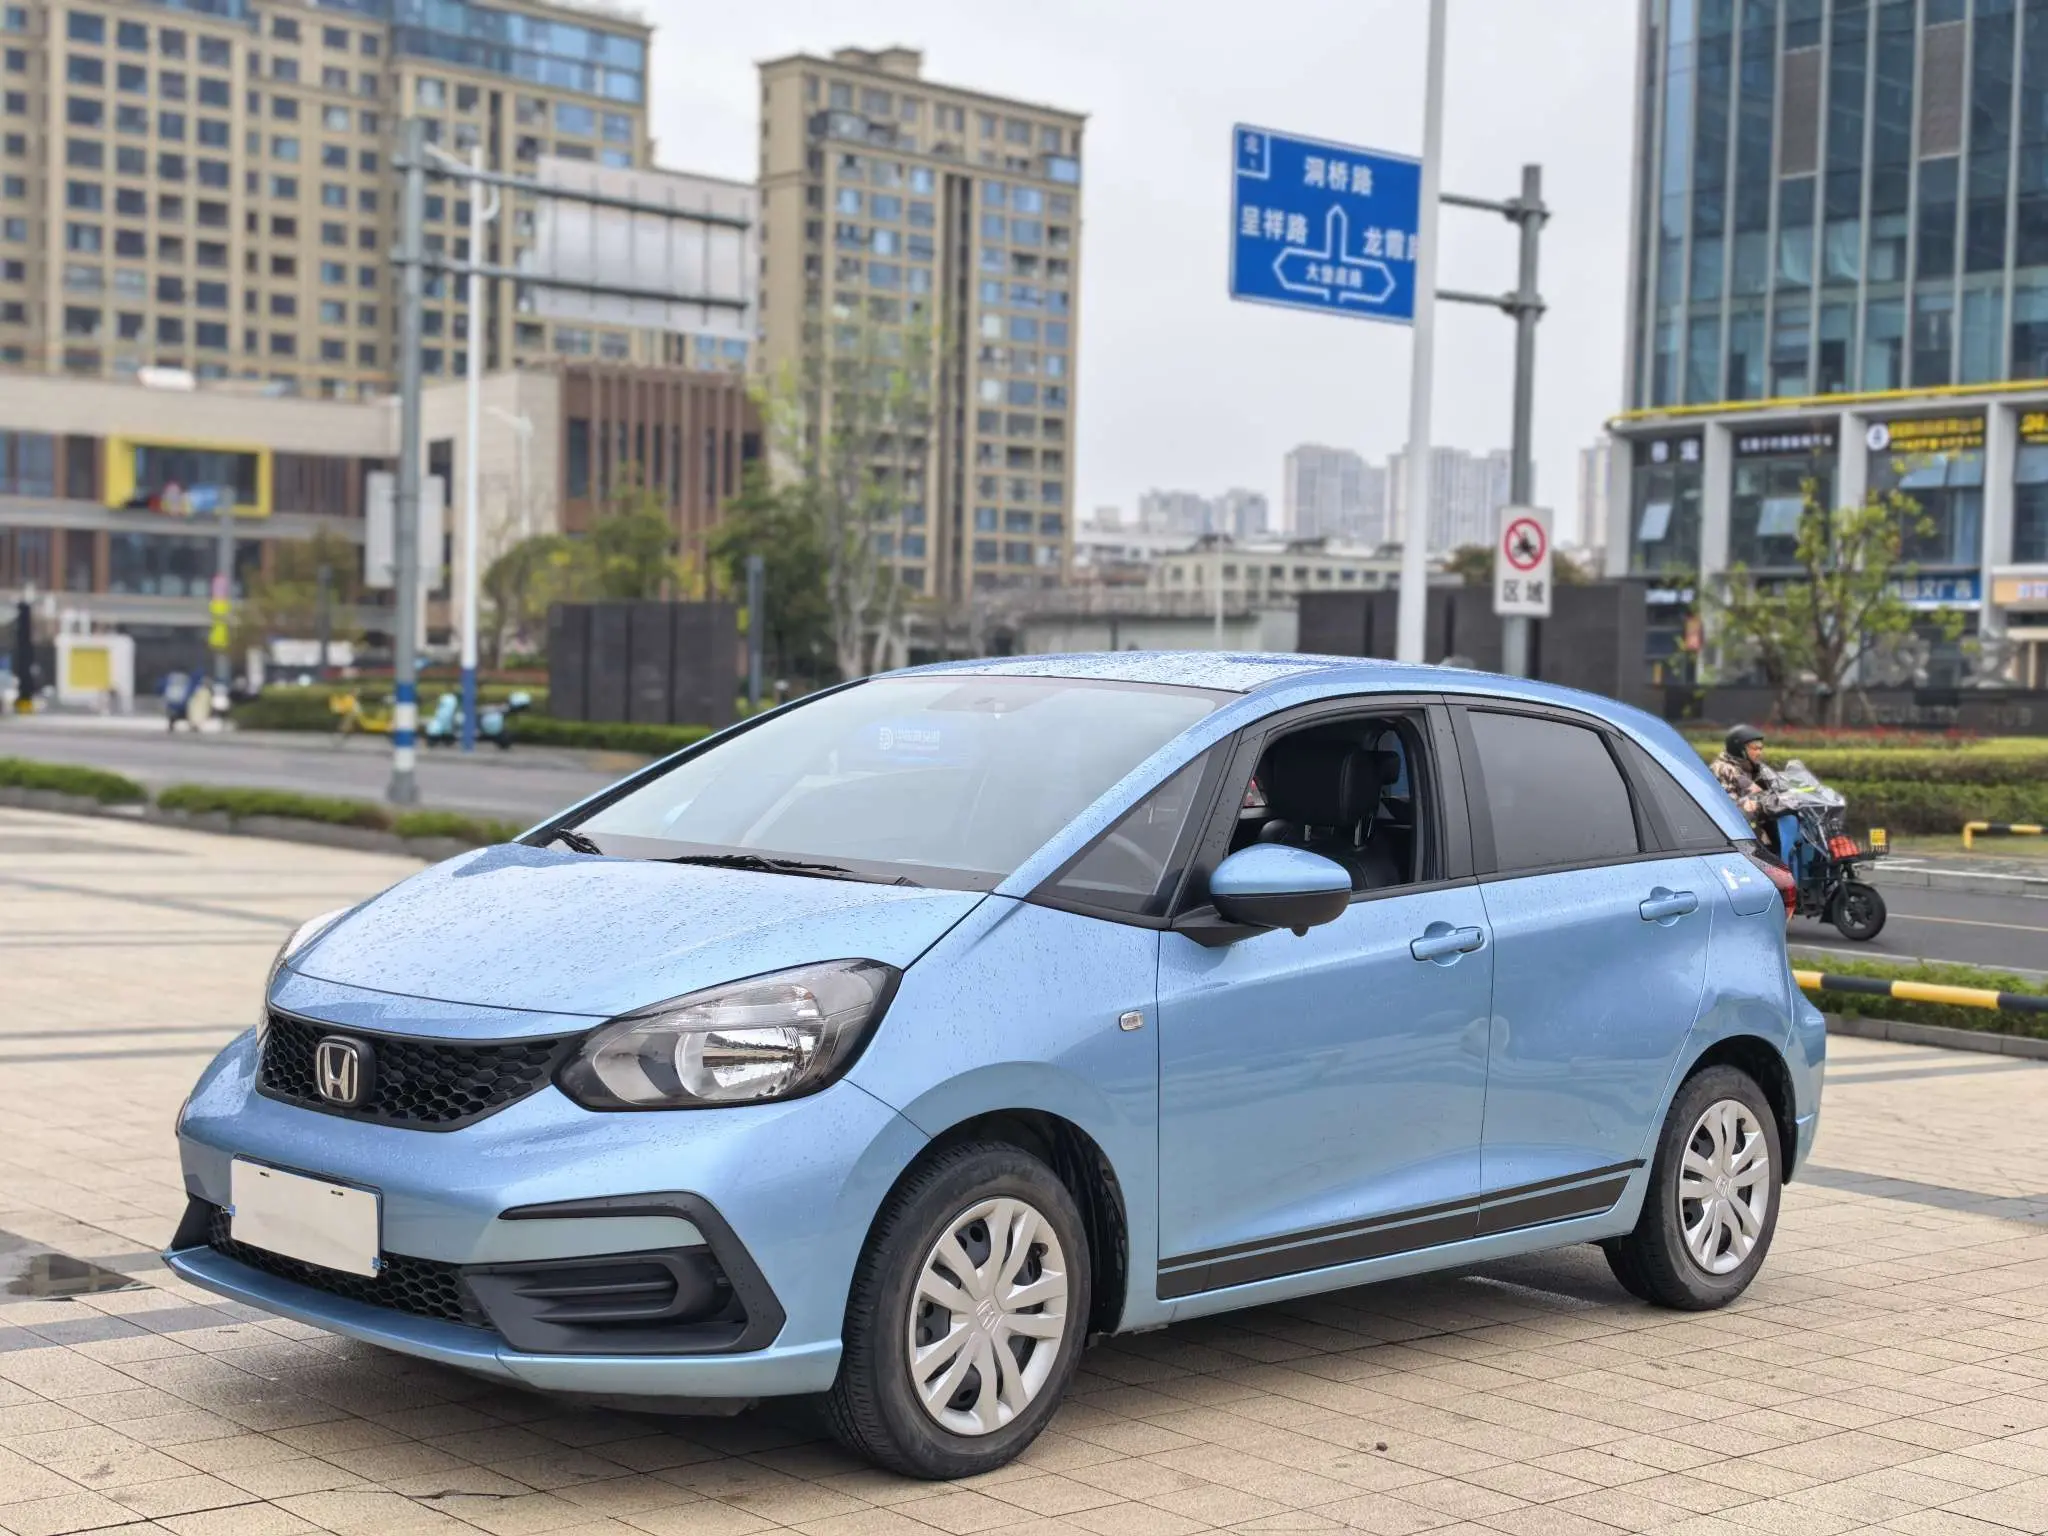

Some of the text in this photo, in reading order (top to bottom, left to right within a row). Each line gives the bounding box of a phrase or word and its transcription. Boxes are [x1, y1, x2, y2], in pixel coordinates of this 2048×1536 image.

[1304, 157, 1373, 196] 洞桥路
[1241, 206, 1307, 244] 呈祥路
[1503, 580, 1543, 603] 区域
